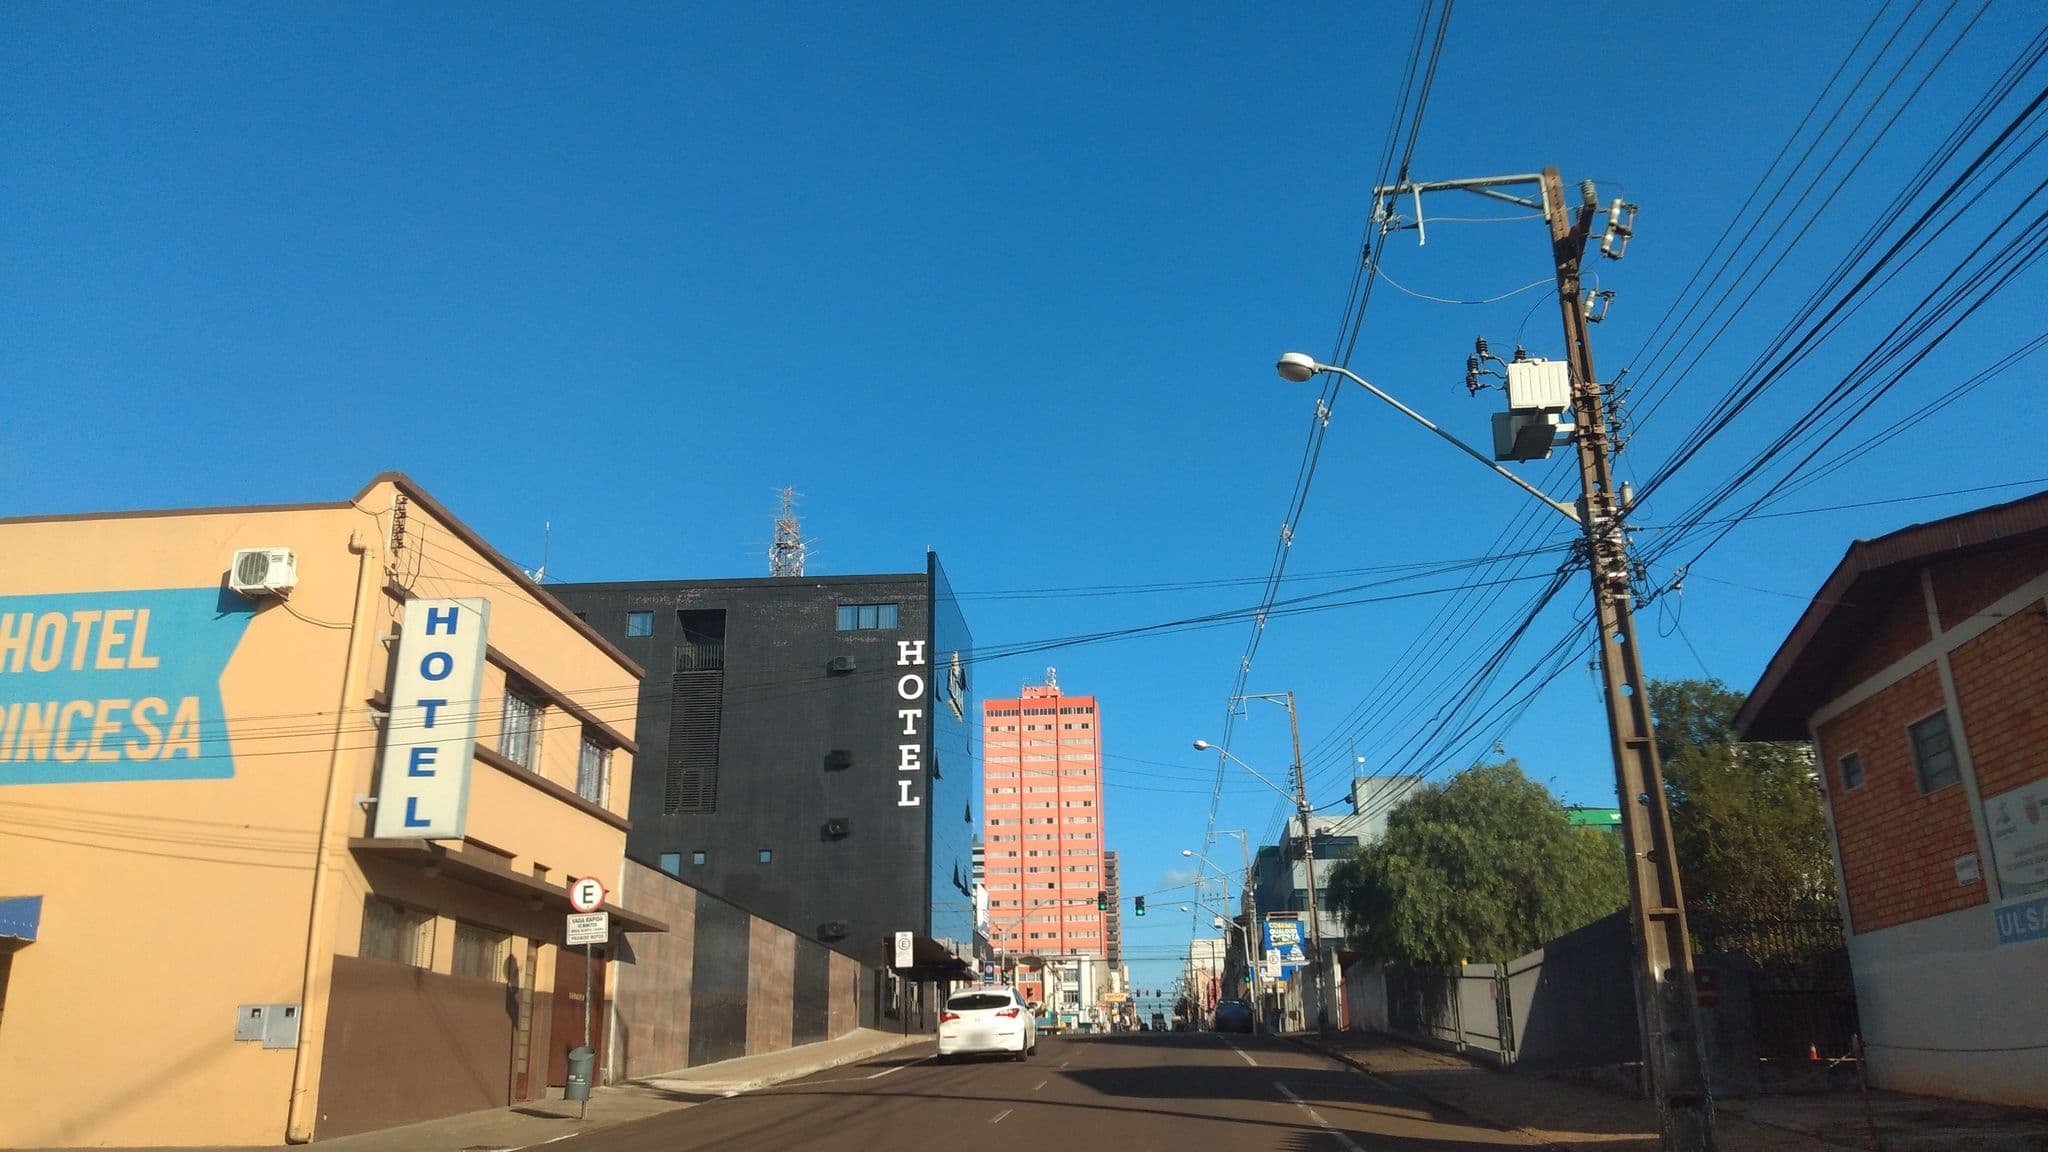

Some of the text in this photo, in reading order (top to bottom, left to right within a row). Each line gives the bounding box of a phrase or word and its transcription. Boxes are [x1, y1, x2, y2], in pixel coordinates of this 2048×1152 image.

[0, 608, 160, 673] HOTEL
[0, 696, 200, 763] INCESA
[404, 607, 459, 827] HOTEL
[897, 640, 926, 807] HOTEL
[583, 885, 594, 904] E
